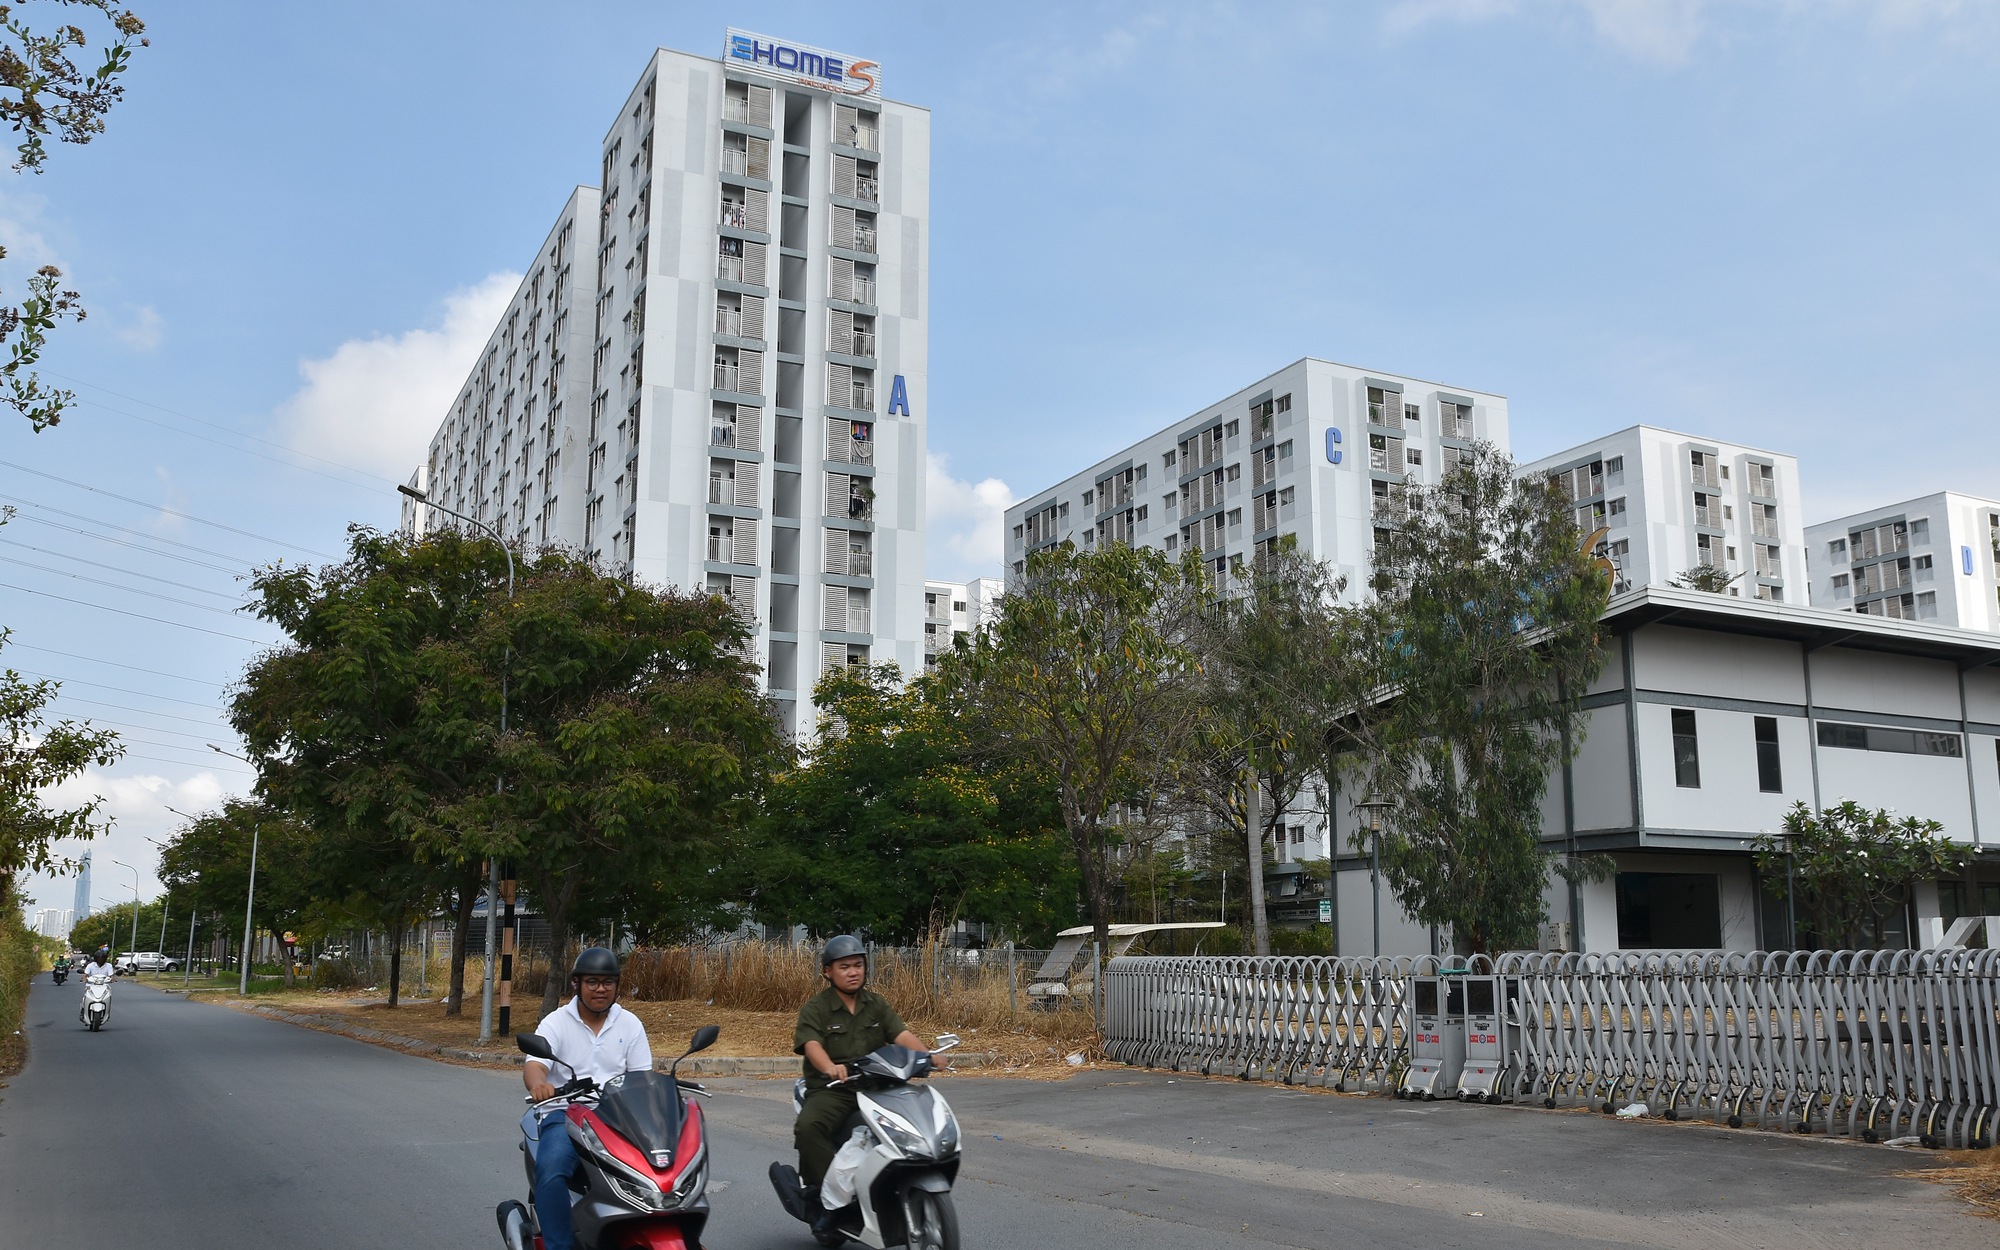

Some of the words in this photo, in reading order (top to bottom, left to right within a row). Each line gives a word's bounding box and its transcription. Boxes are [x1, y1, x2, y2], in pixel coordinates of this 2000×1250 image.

[888, 374, 910, 417] A
[1325, 427, 1342, 465] C
[1961, 545, 1973, 576] D
